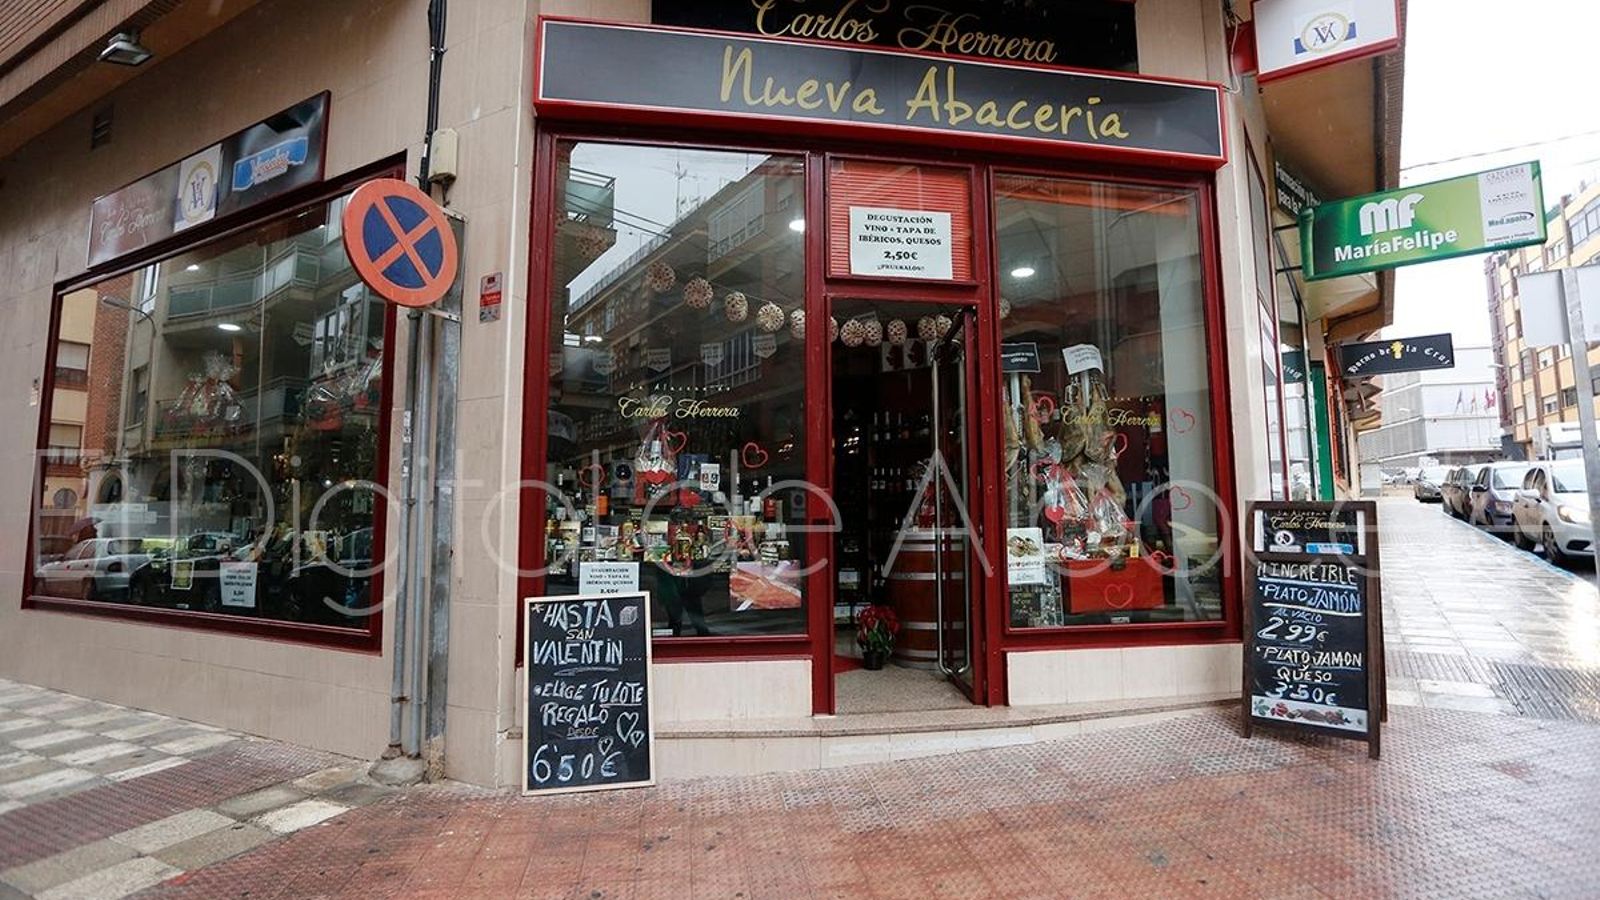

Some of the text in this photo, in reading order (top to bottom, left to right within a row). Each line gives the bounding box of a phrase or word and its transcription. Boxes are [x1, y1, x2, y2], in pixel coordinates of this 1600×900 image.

[752, 0, 1058, 63] Carlos Herrera
[719, 45, 886, 115] Nueva
[867, 213, 933, 224] DEGUSTACIÓN
[864, 224, 888, 232] VINO
[896, 226, 922, 234] TAPA
[923, 227, 937, 235] DE
[905, 236, 942, 246] QUESOS
[1334, 228, 1459, 262] MaríaFelipe
[883, 251, 919, 261] 2,50€
[617, 395, 741, 419] Carlos Herrera
[1263, 584, 1309, 601] PLATO
[565, 628, 596, 640] SAN
[1263, 646, 1311, 664] PLATO
[1276, 666, 1333, 682] QUESO
[540, 701, 609, 728] REGALO
